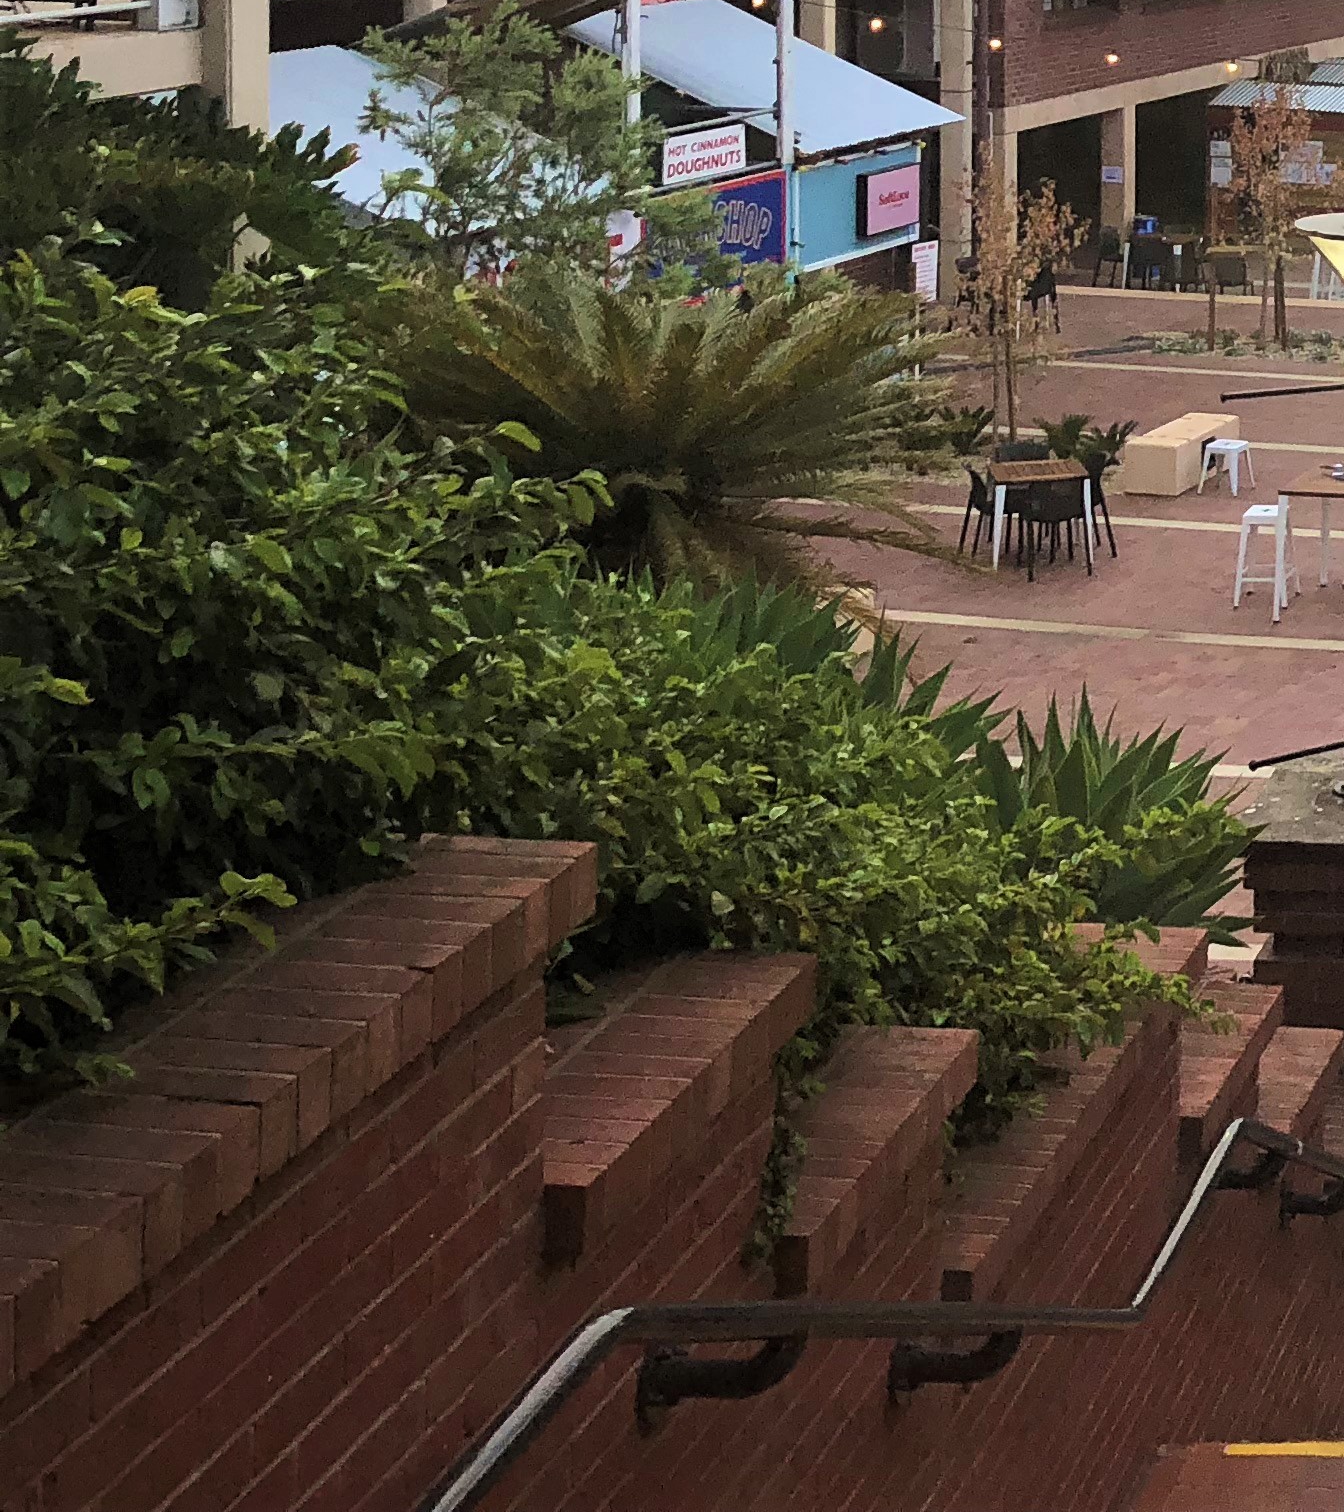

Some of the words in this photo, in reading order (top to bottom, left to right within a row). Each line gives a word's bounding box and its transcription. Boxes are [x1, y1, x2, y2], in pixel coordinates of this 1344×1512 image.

[668, 143, 688, 158] HOT
[690, 134, 740, 153] CINNAMON
[667, 150, 741, 178] DOUGHNUTS
